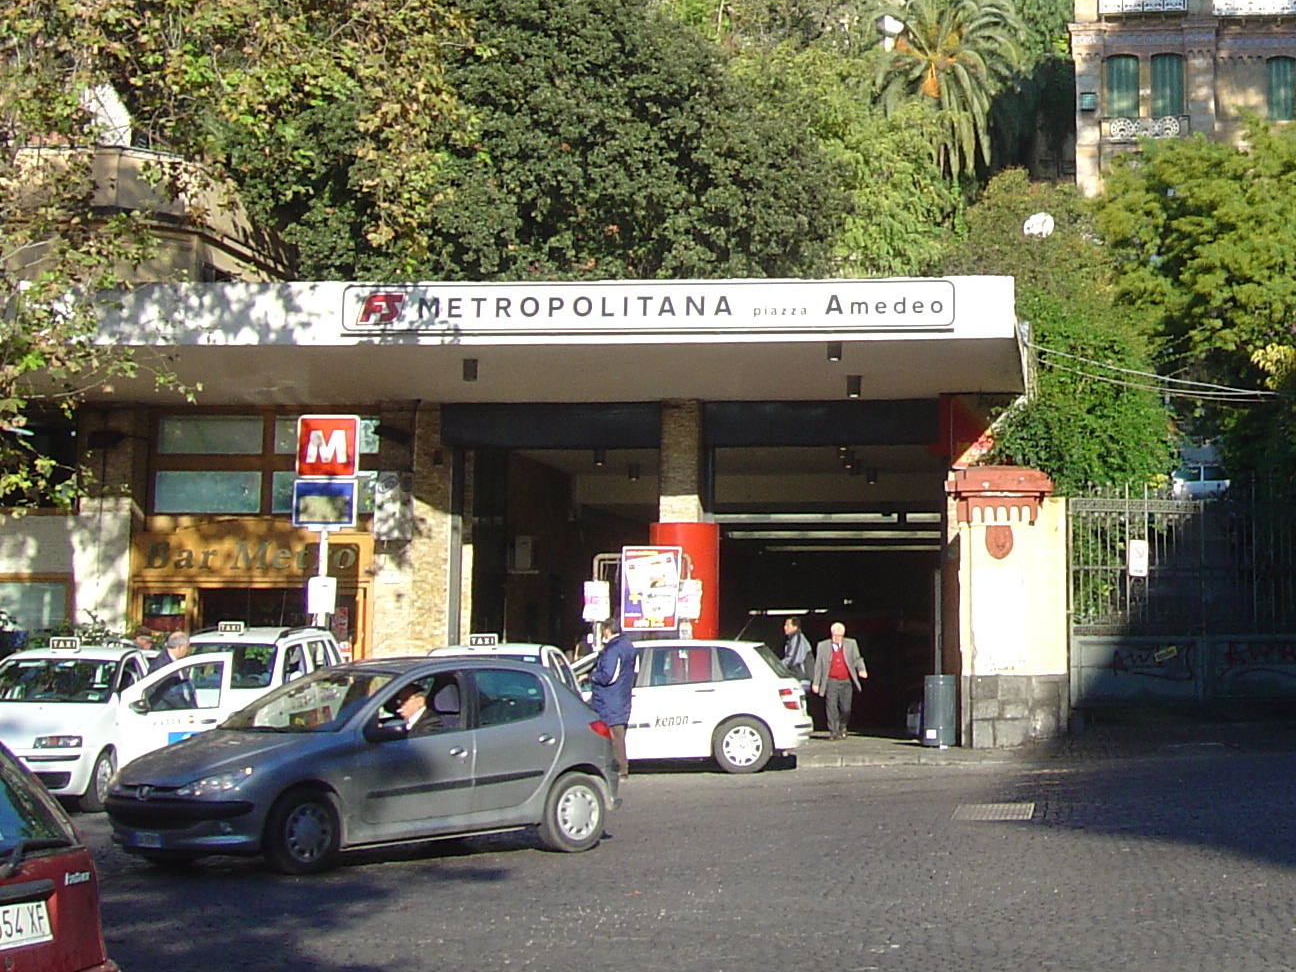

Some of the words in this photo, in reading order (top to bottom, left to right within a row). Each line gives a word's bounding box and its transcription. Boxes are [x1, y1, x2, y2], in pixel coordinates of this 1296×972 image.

[359, 295, 404, 323] FS
[418, 294, 733, 320] METROPOLITANA
[753, 305, 809, 319] piazza
[825, 293, 945, 318] Amedeo
[306, 429, 347, 464] M
[144, 540, 218, 570] Bar
[221, 624, 242, 632] TAXI
[471, 636, 495, 646] TAXI
[52, 639, 77, 649] TAXI
[0, 907, 23, 939] 54
